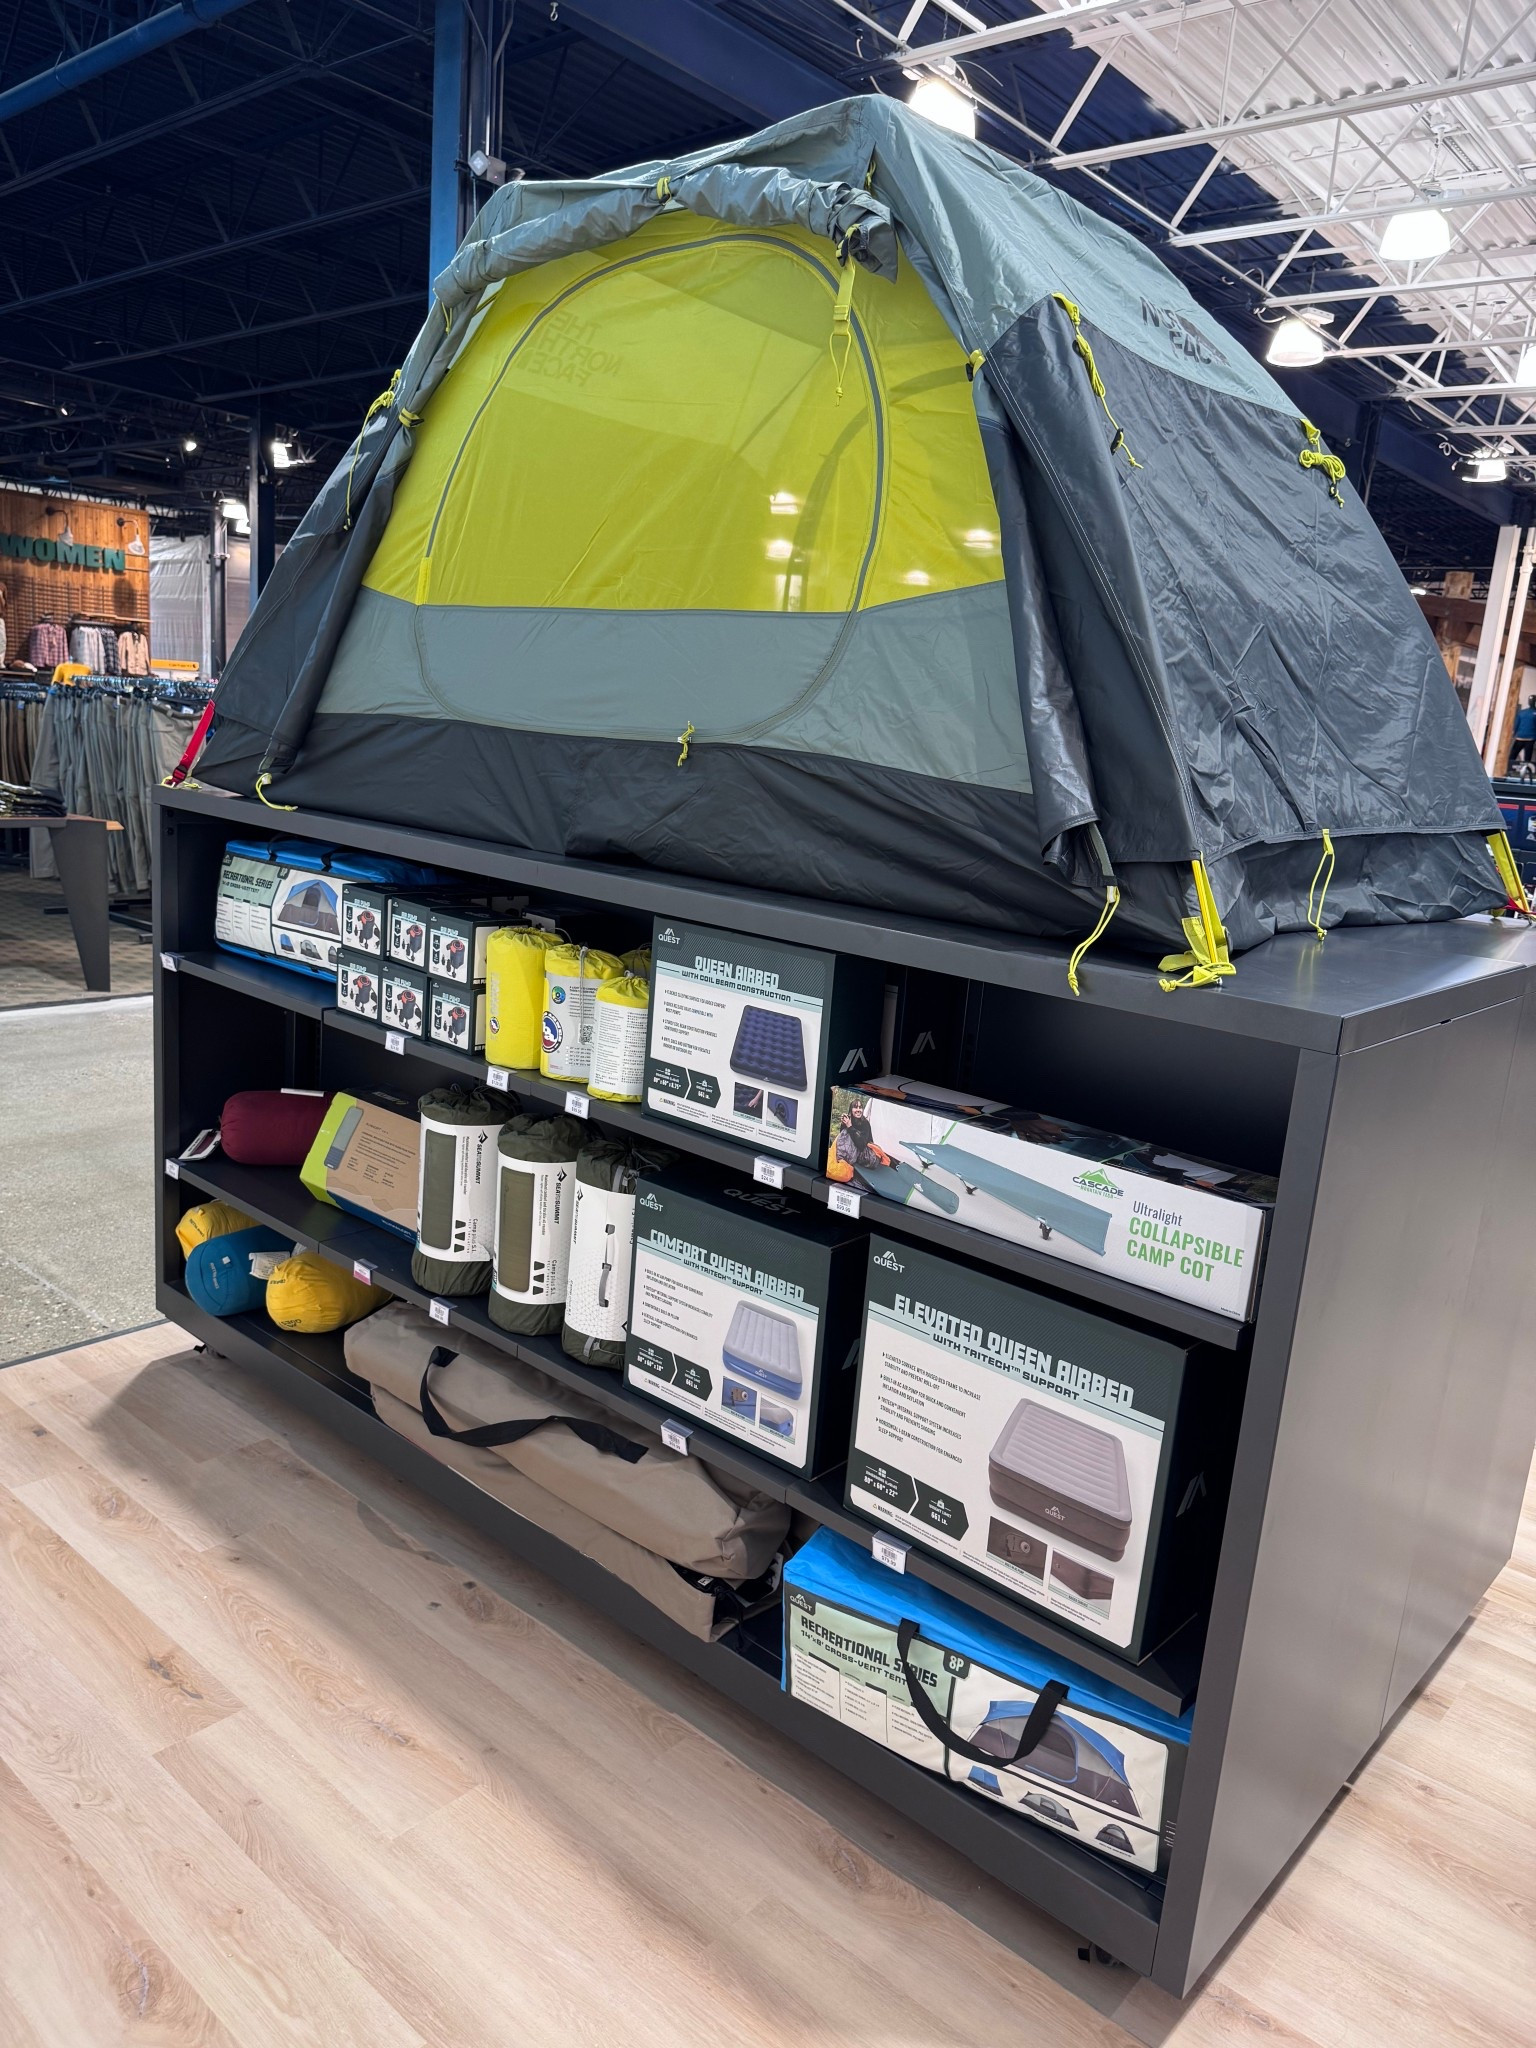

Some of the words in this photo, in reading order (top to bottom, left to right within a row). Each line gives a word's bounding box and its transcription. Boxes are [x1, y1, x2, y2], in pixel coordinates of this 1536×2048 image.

[0, 532, 125, 572] WOMEN
[658, 933, 680, 944] QUEST
[681, 970, 698, 979] WITH
[699, 974, 715, 983] COIL
[715, 978, 735, 988] BEAM
[736, 983, 790, 1002] CONSTRUCTION
[694, 955, 732, 977] QUEEN
[735, 964, 779, 988] AIRBED
[724, 1188, 800, 1215] QUEST
[1072, 1176, 1124, 1197] CASCADE
[639, 1197, 663, 1212] QUEST
[1133, 1201, 1182, 1226] Ultralight
[1129, 1217, 1244, 1267] COLLAPSIBLE
[649, 1228, 707, 1264] COMFORT
[709, 1251, 751, 1282] QUEEN
[754, 1269, 804, 1303] AIRBED
[873, 1254, 904, 1274] QUEST
[1127, 1239, 1175, 1267] CAMP
[1180, 1256, 1214, 1282] COT
[683, 1258, 699, 1270] WITH
[732, 1277, 762, 1295] SUPPORT
[893, 1292, 983, 1347] ELEVATED
[986, 1331, 1052, 1376] QUEEN
[1055, 1358, 1134, 1409] AIRBED
[932, 1333, 961, 1353] WITH
[1022, 1369, 1079, 1401] SUPPORT
[1044, 1508, 1066, 1521] QUEST
[790, 1595, 813, 1612] QUEST
[801, 1615, 890, 1667] RECREATIONAL
[825, 1644, 883, 1674] CROSS-VENT
[949, 1655, 964, 1671] 8P
